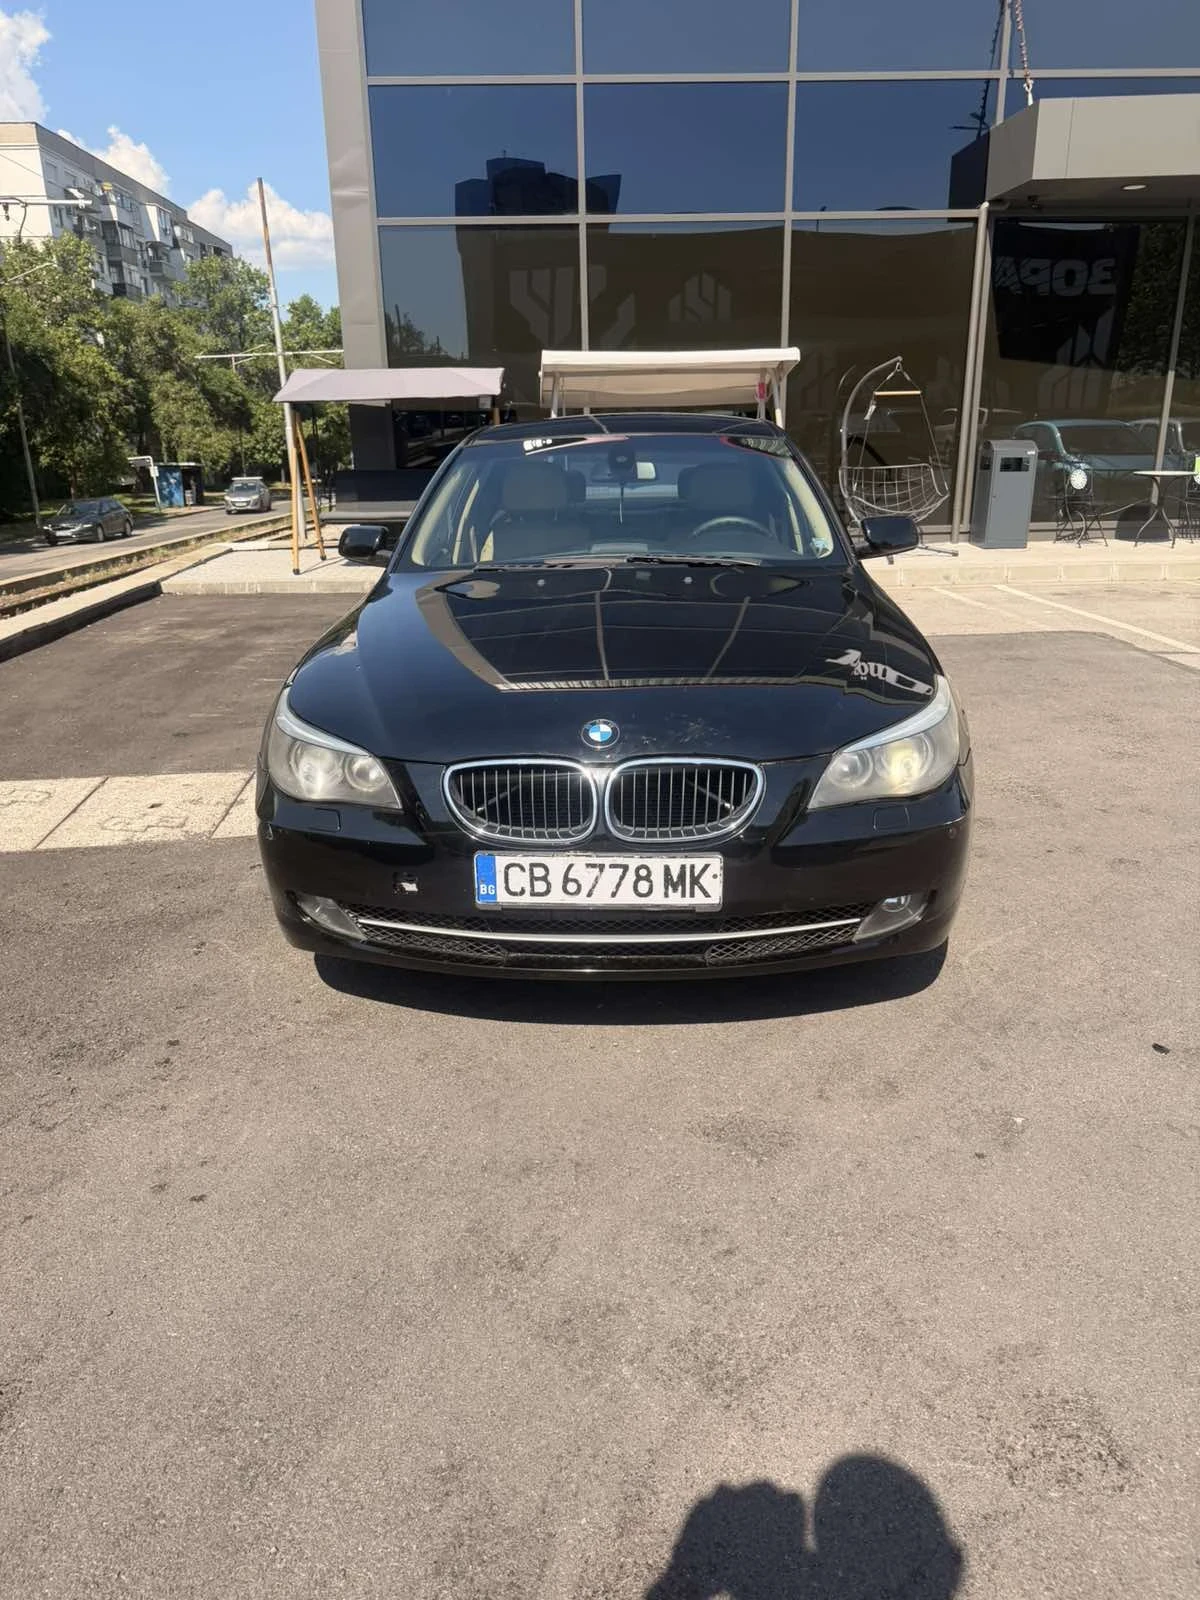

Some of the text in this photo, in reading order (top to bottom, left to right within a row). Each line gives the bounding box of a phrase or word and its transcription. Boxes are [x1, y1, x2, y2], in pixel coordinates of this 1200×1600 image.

[480, 884, 496, 895] BG
[503, 862, 712, 898] CB 6778 MK
